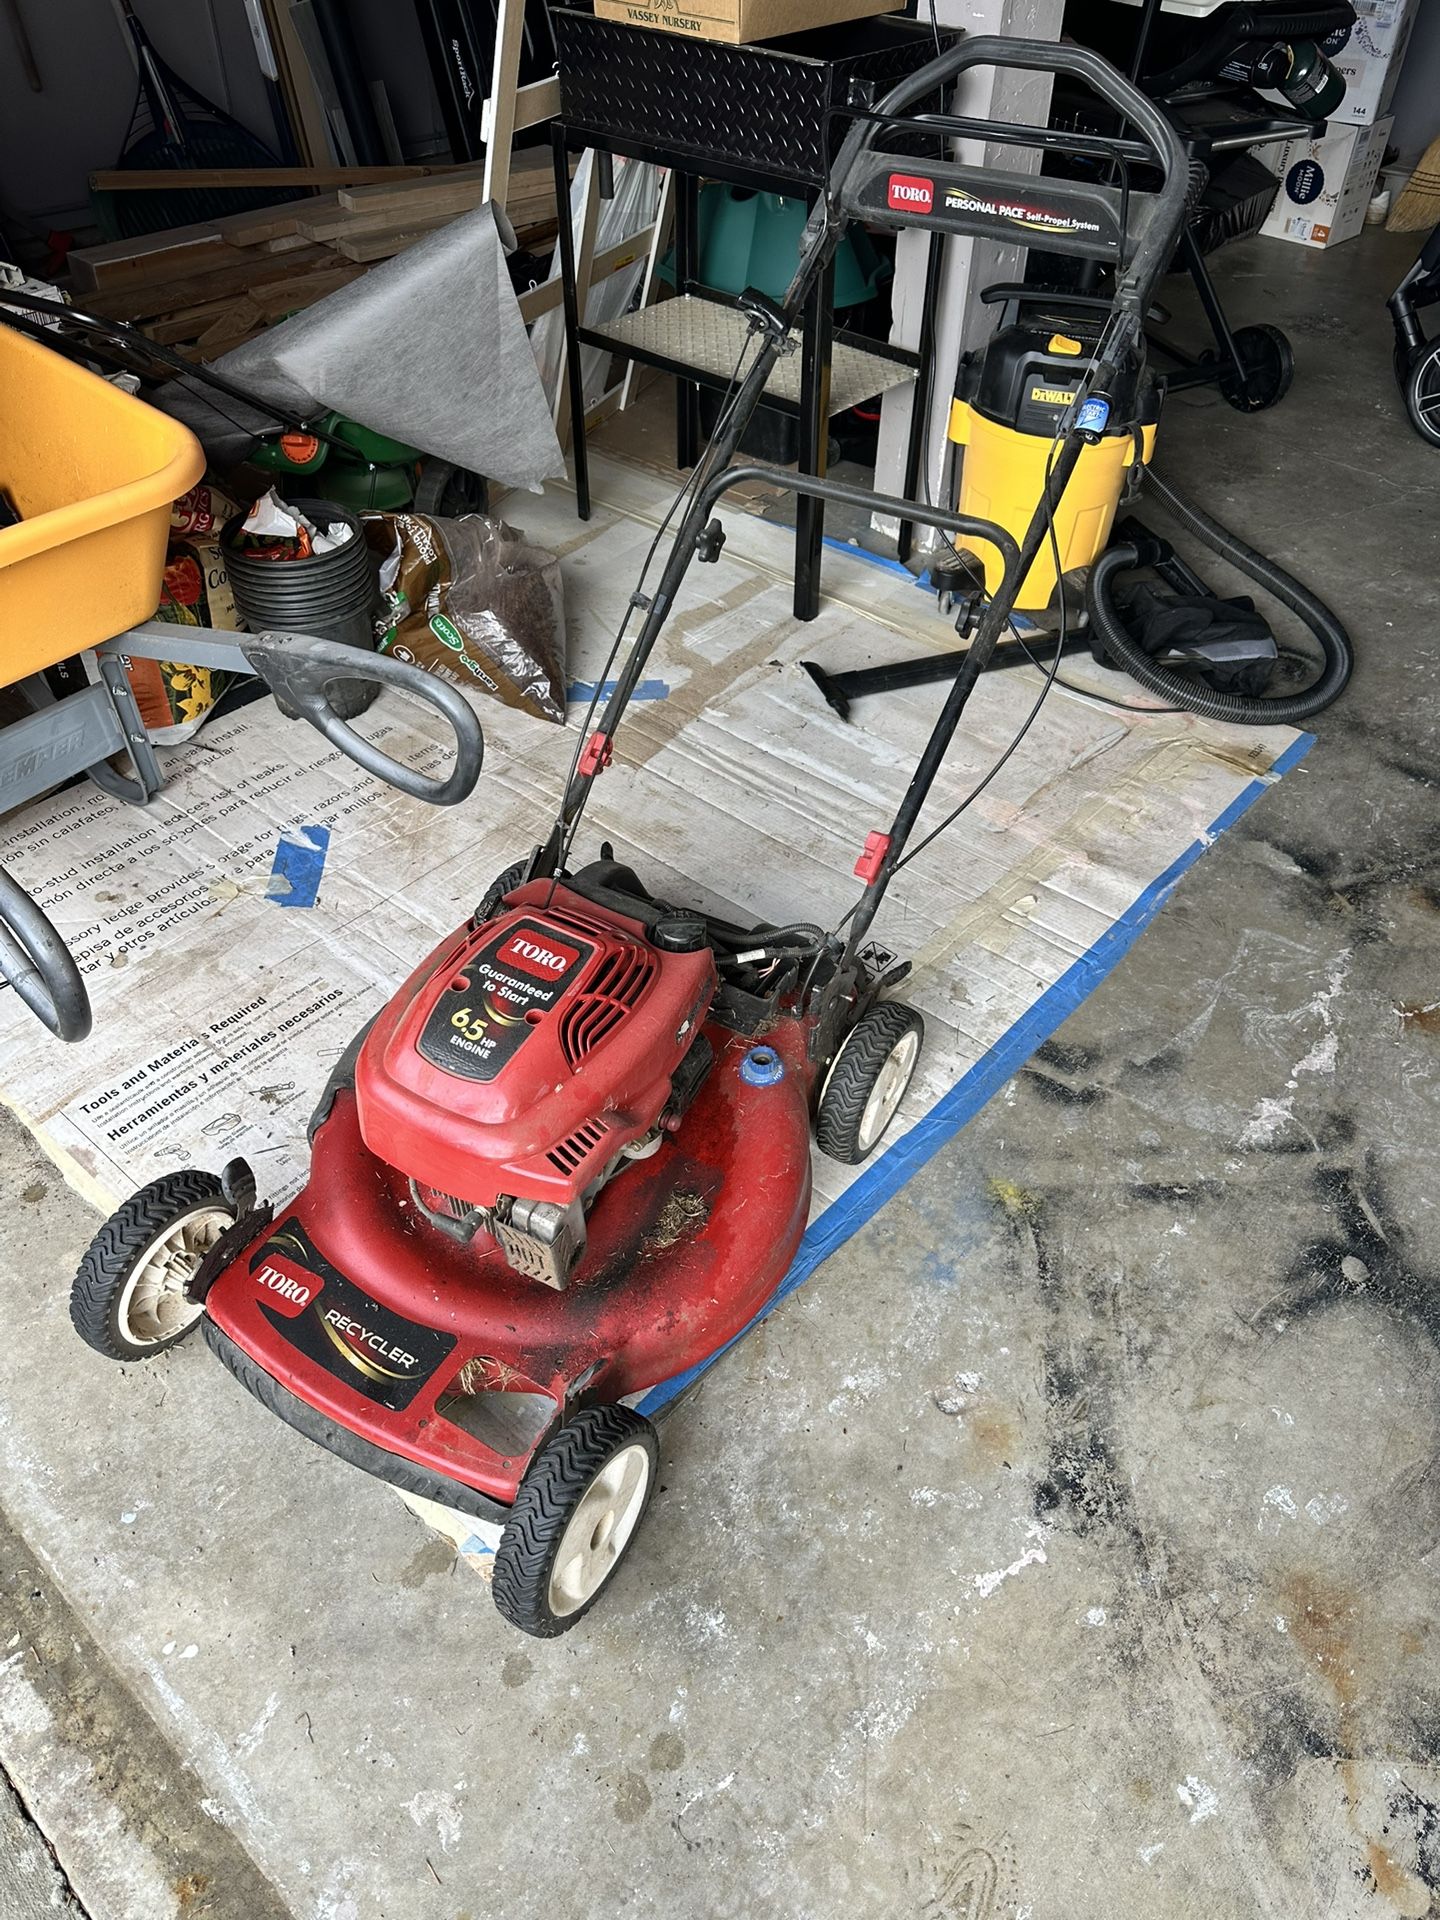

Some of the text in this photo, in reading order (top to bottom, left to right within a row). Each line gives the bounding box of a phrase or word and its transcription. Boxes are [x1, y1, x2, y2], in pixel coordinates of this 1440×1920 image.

[627, 8, 702, 31] VASSEY NURSERY
[1352, 107, 1366, 115] 144
[891, 185, 932, 203] TORO
[1294, 169, 1305, 194] MOON
[1299, 165, 1315, 200] Millie
[945, 197, 1100, 231] PERSONAL PACE Self-Propel System
[413, 523, 438, 562] LOCALLY
[413, 532, 432, 566] PROUD
[433, 618, 460, 646] Scotts
[163, 756, 179, 768] an
[27, 867, 79, 898] to-stud
[81, 827, 157, 870] installation
[211, 787, 236, 803] risk
[237, 778, 250, 790] of
[251, 763, 290, 783] leaks.
[29, 835, 50, 853] sin
[52, 804, 120, 840] calafateo,
[41, 889, 74, 911] ción
[76, 862, 126, 891] directa
[127, 855, 138, 865] a
[141, 843, 161, 857] los
[218, 799, 249, 820] para
[249, 775, 293, 801] reducir
[294, 767, 308, 779] el
[309, 749, 345, 772] riesgo
[364, 724, 398, 742] ugas.
[65, 922, 102, 947] ssory
[103, 900, 145, 926] ledge
[146, 866, 205, 903] provides
[205, 842, 255, 869] sorage
[254, 828, 274, 845] for
[313, 789, 351, 812] razors
[352, 776, 375, 793] and
[74, 938, 112, 964] episa
[114, 925, 135, 941] de
[136, 885, 210, 928] accesorios
[246, 848, 276, 871] para
[344, 788, 388, 815] anillos,
[442, 749, 459, 761] de
[104, 950, 117, 963] y
[117, 931, 156, 954] otros
[510, 938, 569, 972] TORO
[478, 964, 554, 1001] Guaranteed
[482, 980, 530, 1006] to Start
[450, 1008, 497, 1049] 6.5 HP
[79, 1089, 120, 1115] Tools
[121, 1069, 148, 1090] and
[210, 996, 268, 1033] Required
[106, 1079, 198, 1142] Herramientas
[198, 1071, 210, 1084] y
[209, 1028, 277, 1075] materiales
[276, 987, 344, 1033] necesarios
[450, 1034, 491, 1060] ENGINE
[256, 1265, 311, 1307] TORO
[324, 1308, 418, 1369] RECYCLER
